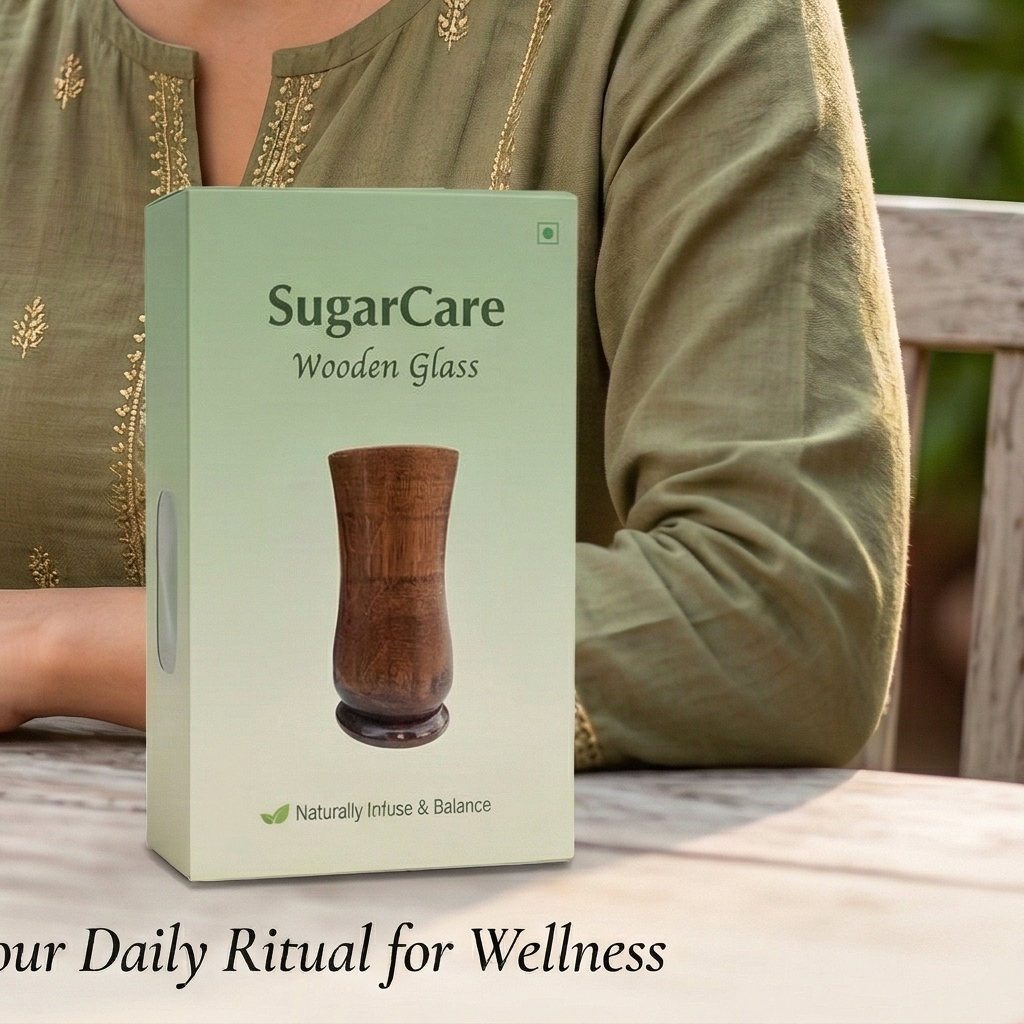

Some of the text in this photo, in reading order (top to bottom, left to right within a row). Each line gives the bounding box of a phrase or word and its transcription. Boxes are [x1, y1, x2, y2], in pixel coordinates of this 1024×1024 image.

[268, 283, 506, 339] SugarCare
[292, 346, 480, 388] Wooden Glass
[296, 797, 492, 823] Naturally Infuse & Balance
